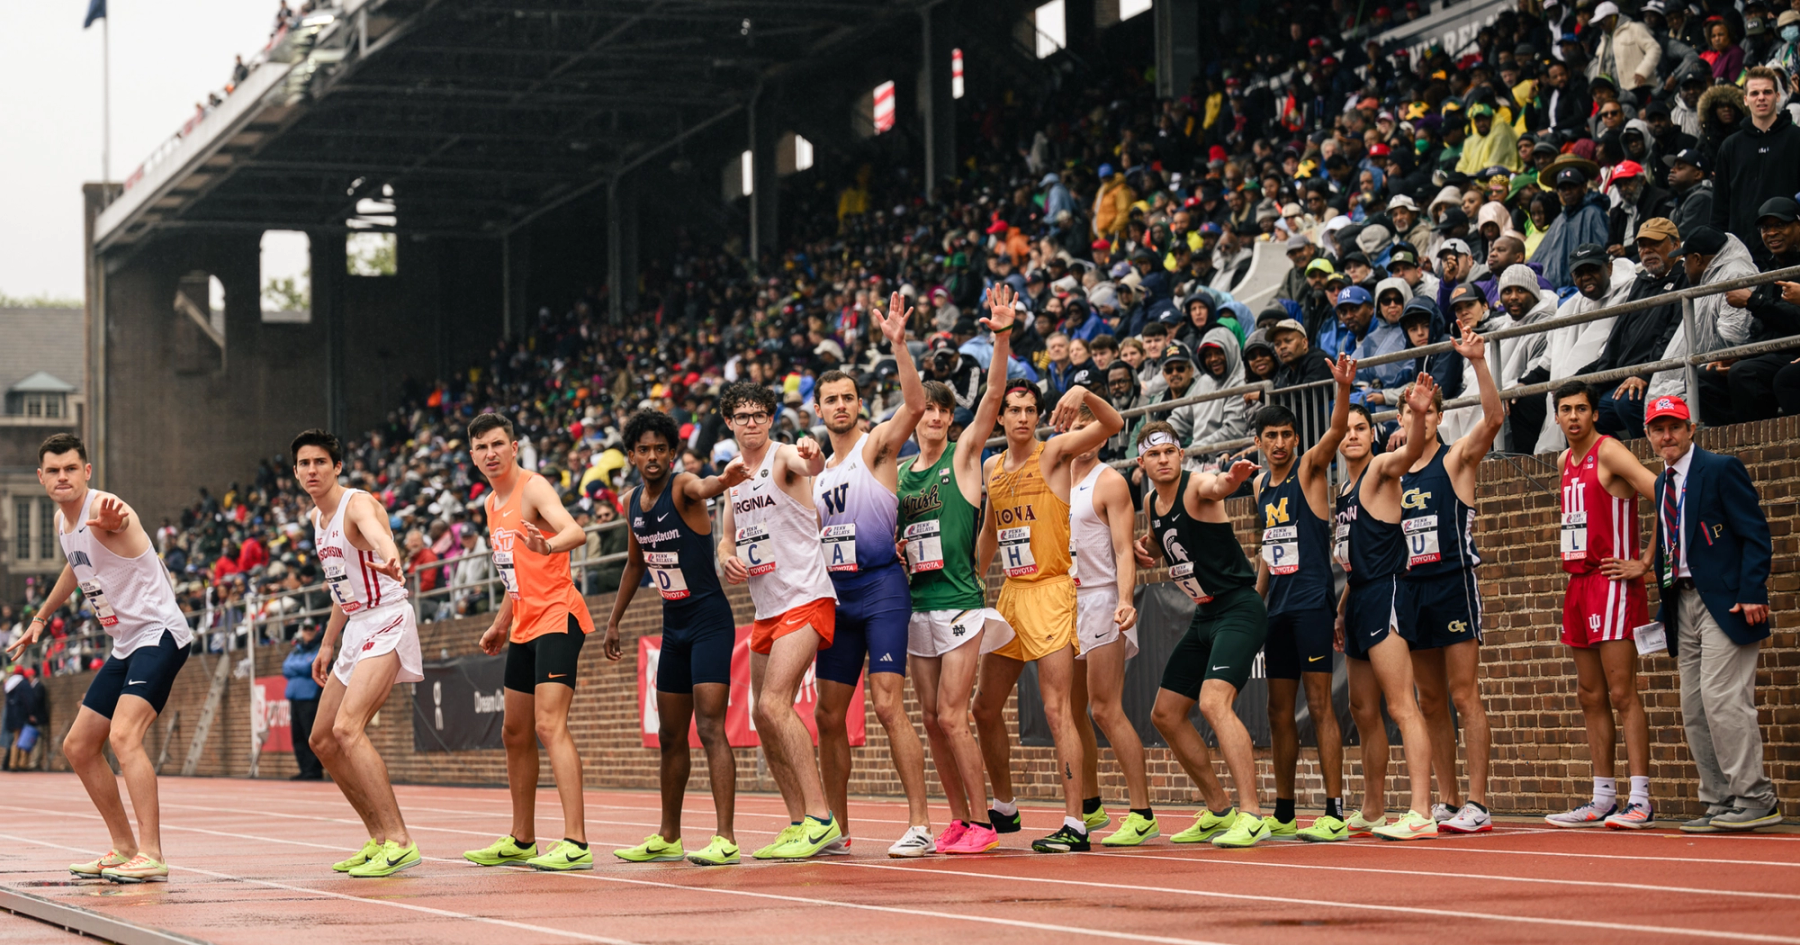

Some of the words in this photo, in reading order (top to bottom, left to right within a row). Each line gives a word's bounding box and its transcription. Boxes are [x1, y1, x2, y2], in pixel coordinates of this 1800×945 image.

[821, 482, 850, 516] W
[902, 484, 942, 520] Irish
[1400, 487, 1432, 510] GT
[1265, 496, 1290, 528] M
[746, 529, 763, 537] RELAYS
[1572, 530, 1579, 550] L
[1711, 523, 1723, 539] P
[748, 543, 761, 565] C
[832, 543, 845, 564] A
[1412, 534, 1425, 555] U
[1007, 545, 1022, 567] H
[1272, 545, 1285, 565] P
[1412, 554, 1437, 564] TOYOTA
[750, 564, 773, 575] TOYOTA
[917, 561, 939, 570] OYOTA
[1011, 566, 1034, 576] TOYOTA
[500, 570, 510, 590] B
[657, 570, 671, 590] D
[1183, 581, 1198, 597] S
[332, 583, 346, 603] E
[1448, 619, 1468, 633] GT
[474, 690, 495, 713] Dream
